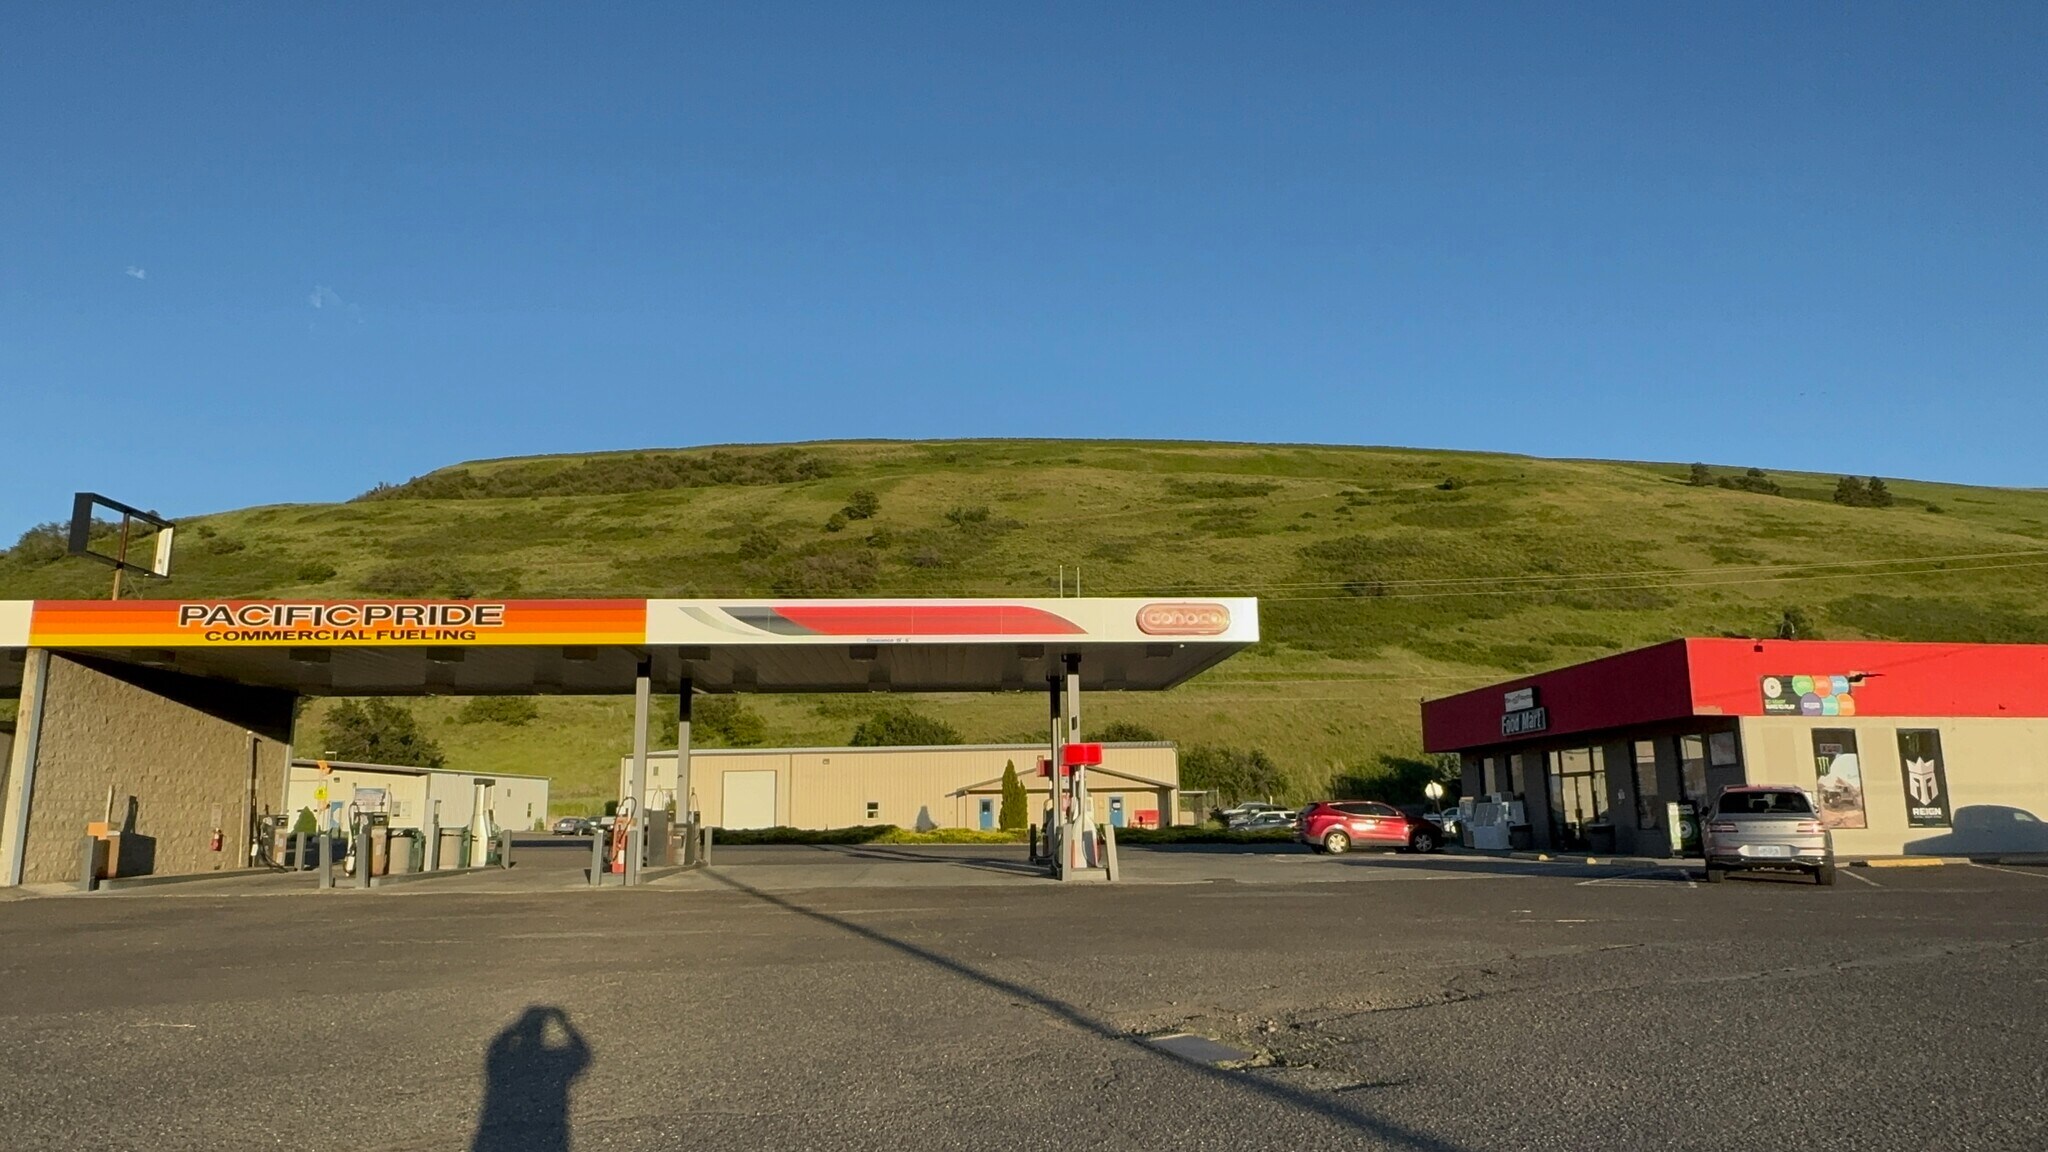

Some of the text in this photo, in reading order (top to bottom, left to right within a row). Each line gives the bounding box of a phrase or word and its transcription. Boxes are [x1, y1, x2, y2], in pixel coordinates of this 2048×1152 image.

[205, 629, 476, 641] COMMERCIAL FUELING
[1503, 711, 1541, 734] Food Mart
[1912, 807, 1942, 816] REIGN
